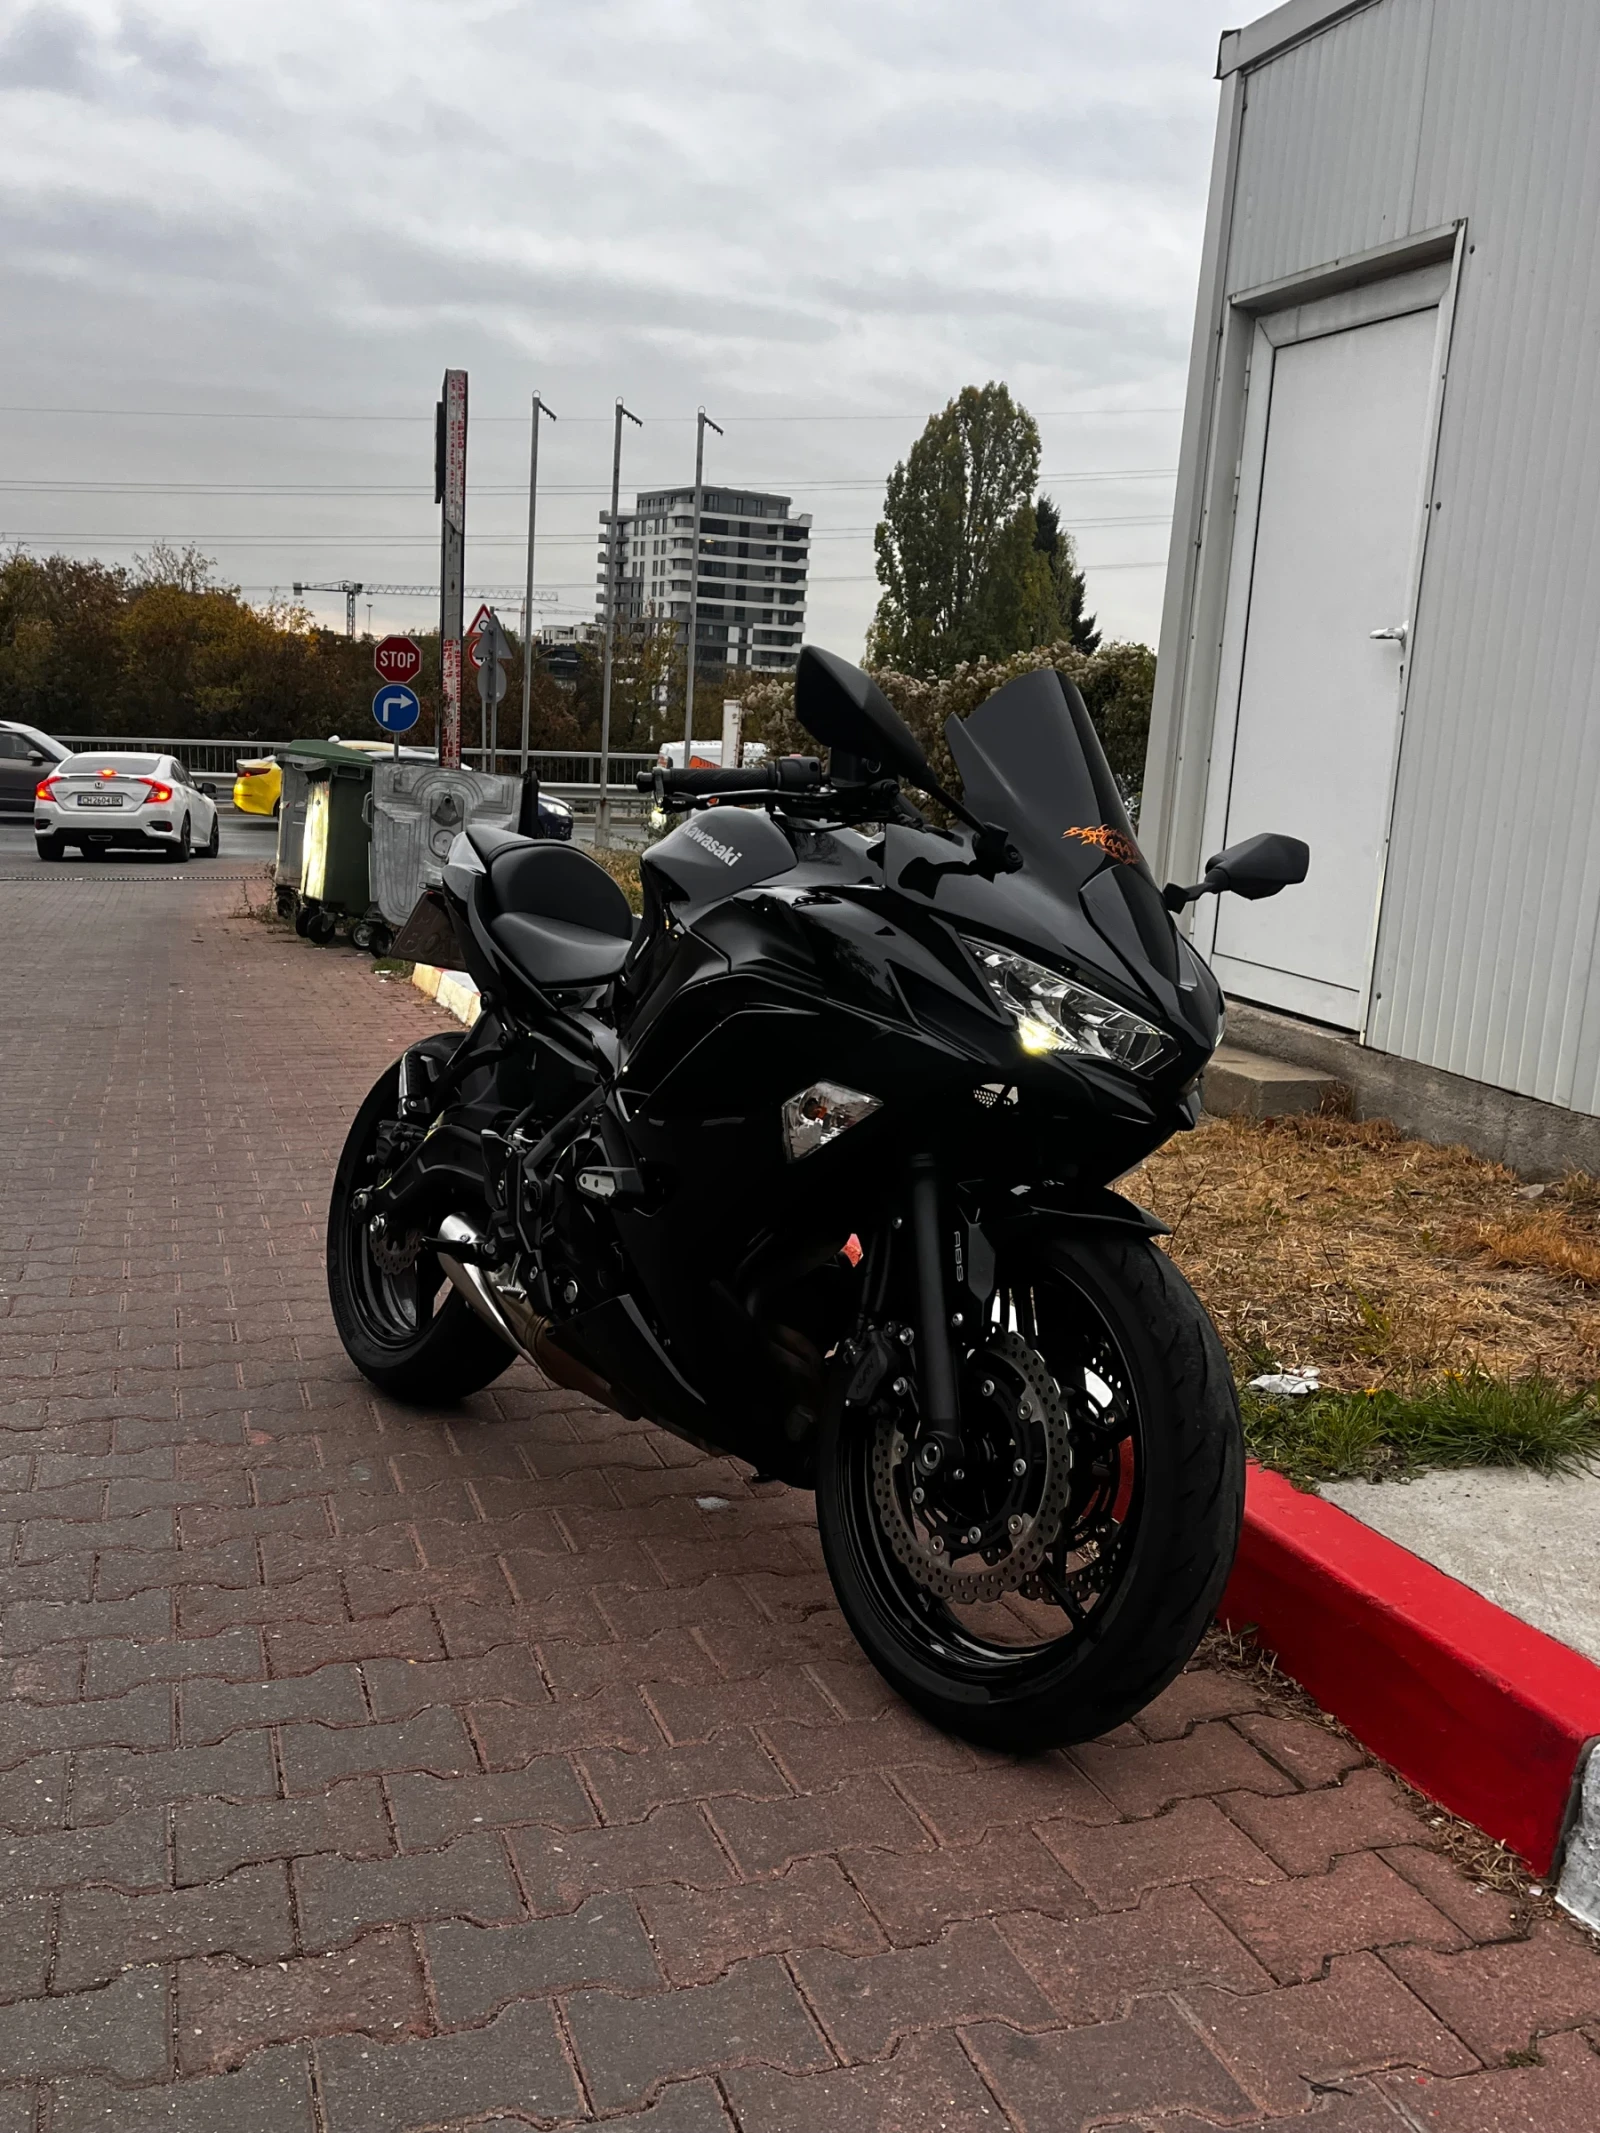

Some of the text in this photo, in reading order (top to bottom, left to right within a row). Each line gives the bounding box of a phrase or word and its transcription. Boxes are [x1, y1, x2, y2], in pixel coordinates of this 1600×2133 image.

[380, 650, 416, 668] STOP
[681, 821, 742, 867] Kawasaki
[953, 1230, 964, 1282] ABS
